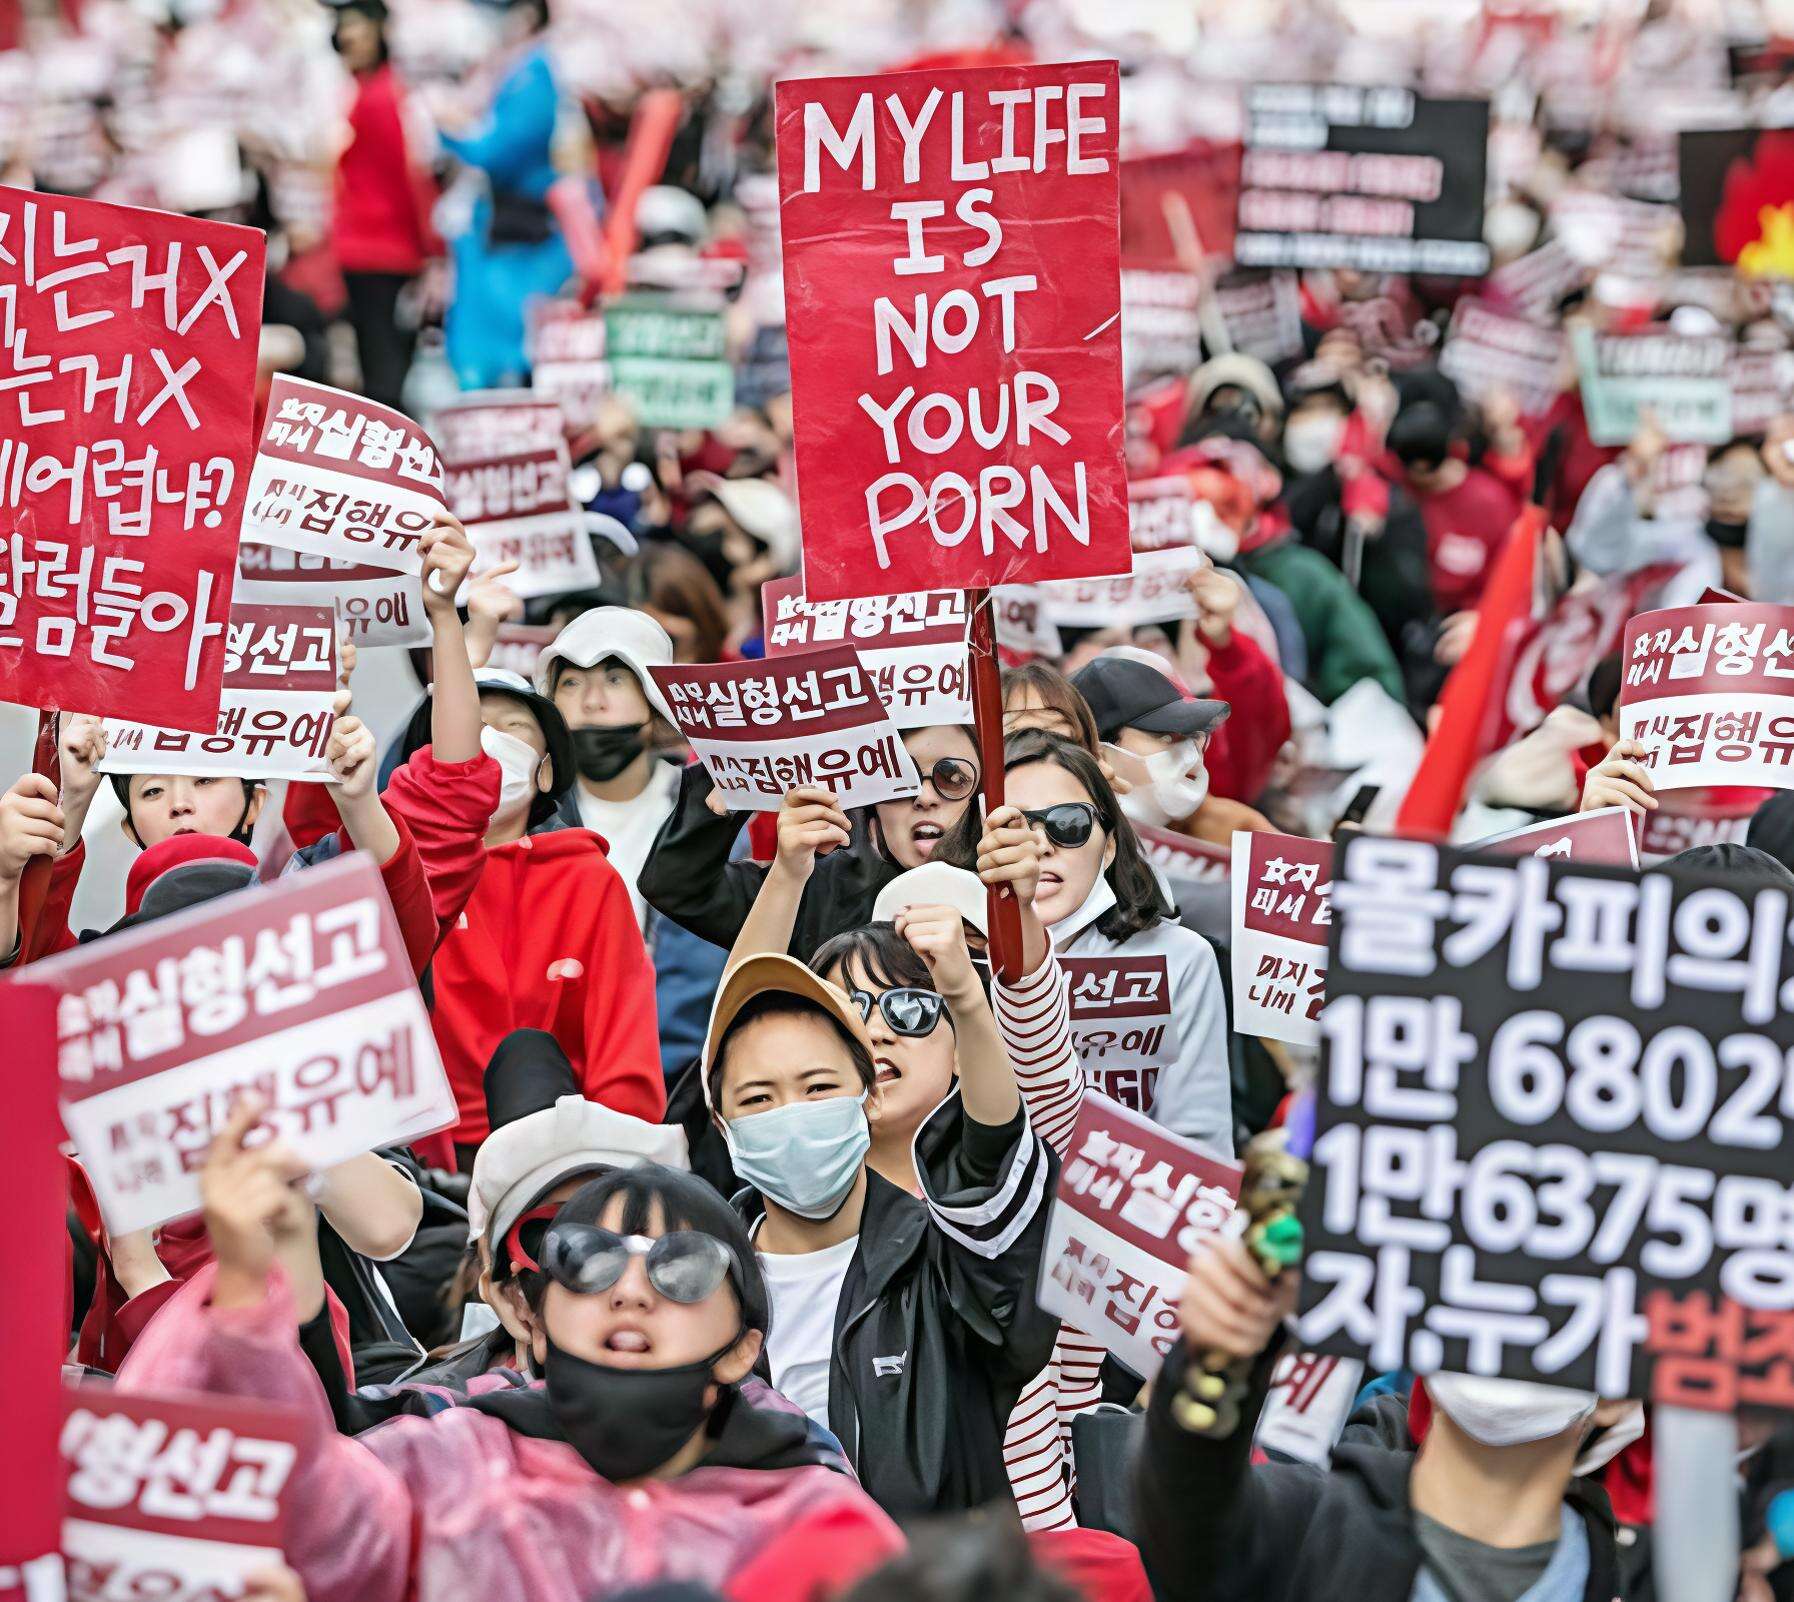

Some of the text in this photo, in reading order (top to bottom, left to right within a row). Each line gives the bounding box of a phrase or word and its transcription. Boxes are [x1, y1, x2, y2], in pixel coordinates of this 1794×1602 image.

[890, 188, 1003, 275] IS
[874, 275, 1038, 375] NOT
[858, 371, 1071, 464] YOUR
[864, 461, 1090, 569] PORN
[1333, 836, 1794, 1027] 몰카피의
